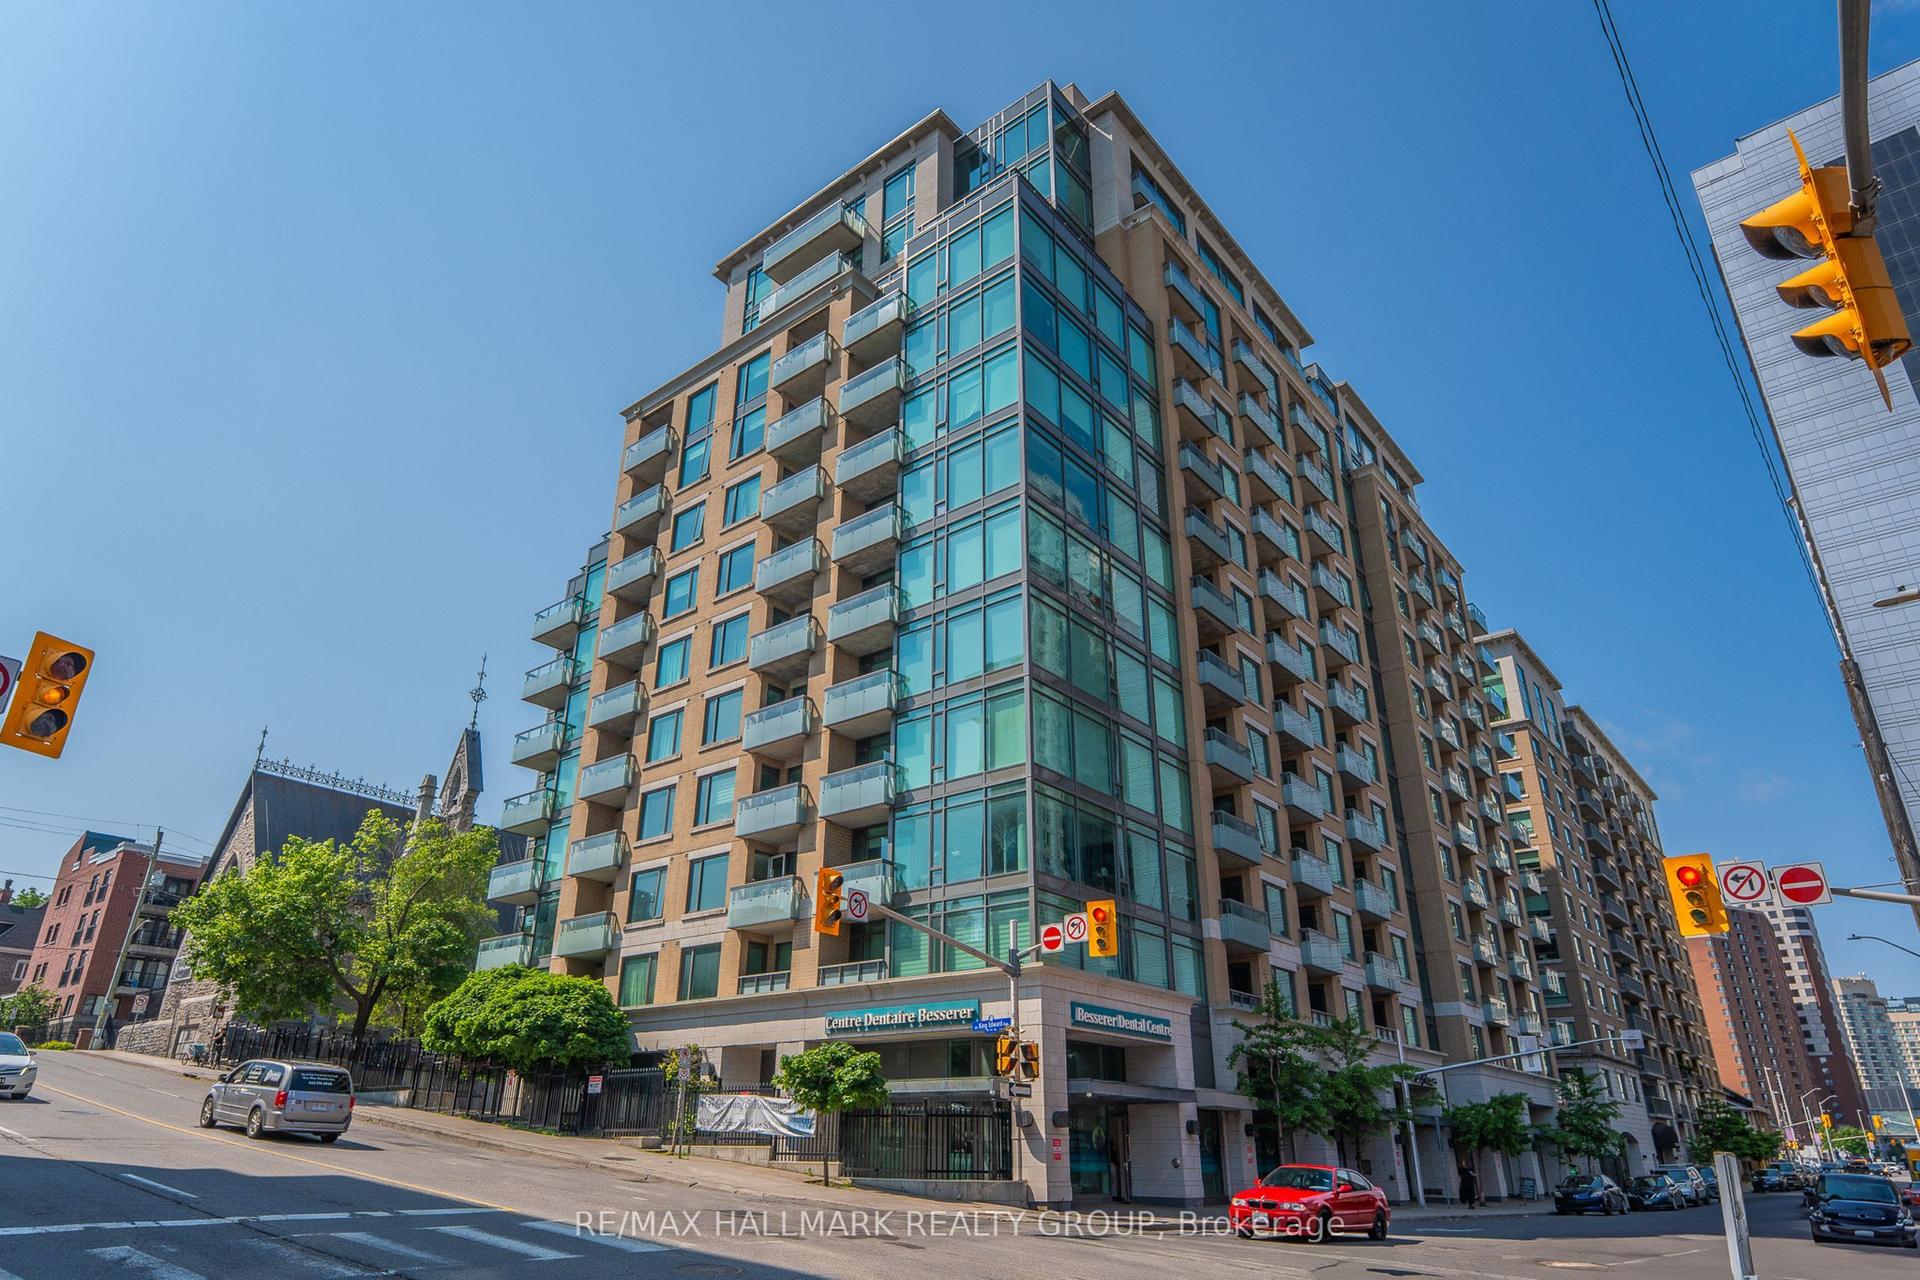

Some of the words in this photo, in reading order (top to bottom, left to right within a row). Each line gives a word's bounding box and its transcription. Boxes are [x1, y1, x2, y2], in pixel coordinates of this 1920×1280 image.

[825, 1015, 862, 1029] Centre
[863, 1011, 915, 1027] Dentaire
[918, 1007, 974, 1022] Besserer
[1075, 1007, 1118, 1027] Besserer
[1118, 1015, 1145, 1032] Dental
[1146, 1020, 1173, 1037] Centre
